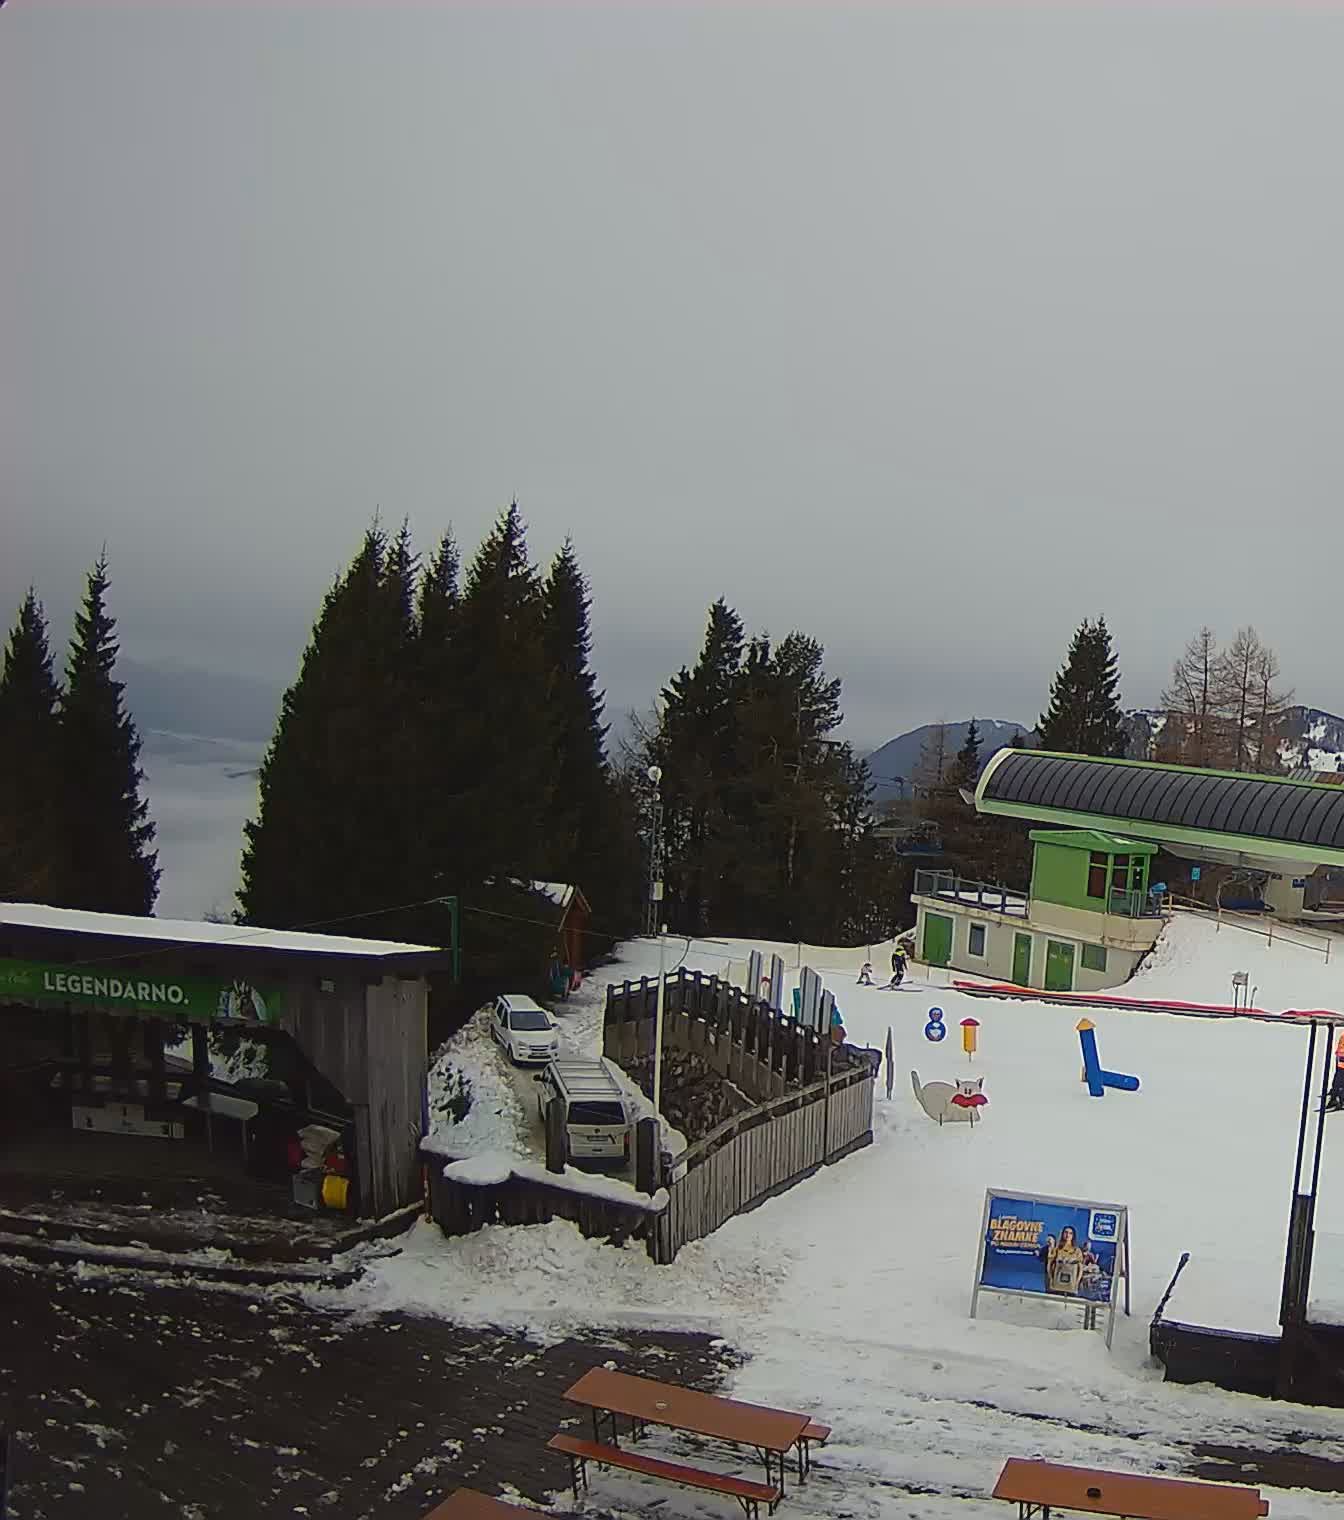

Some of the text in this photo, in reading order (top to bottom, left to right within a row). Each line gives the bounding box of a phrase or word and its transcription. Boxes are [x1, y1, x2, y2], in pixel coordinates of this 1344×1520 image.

[43, 971, 190, 1005] LEGENDARNO.
[990, 1218, 1044, 1232] BLAGOVNE
[992, 1230, 1039, 1243] ZNAMKE
